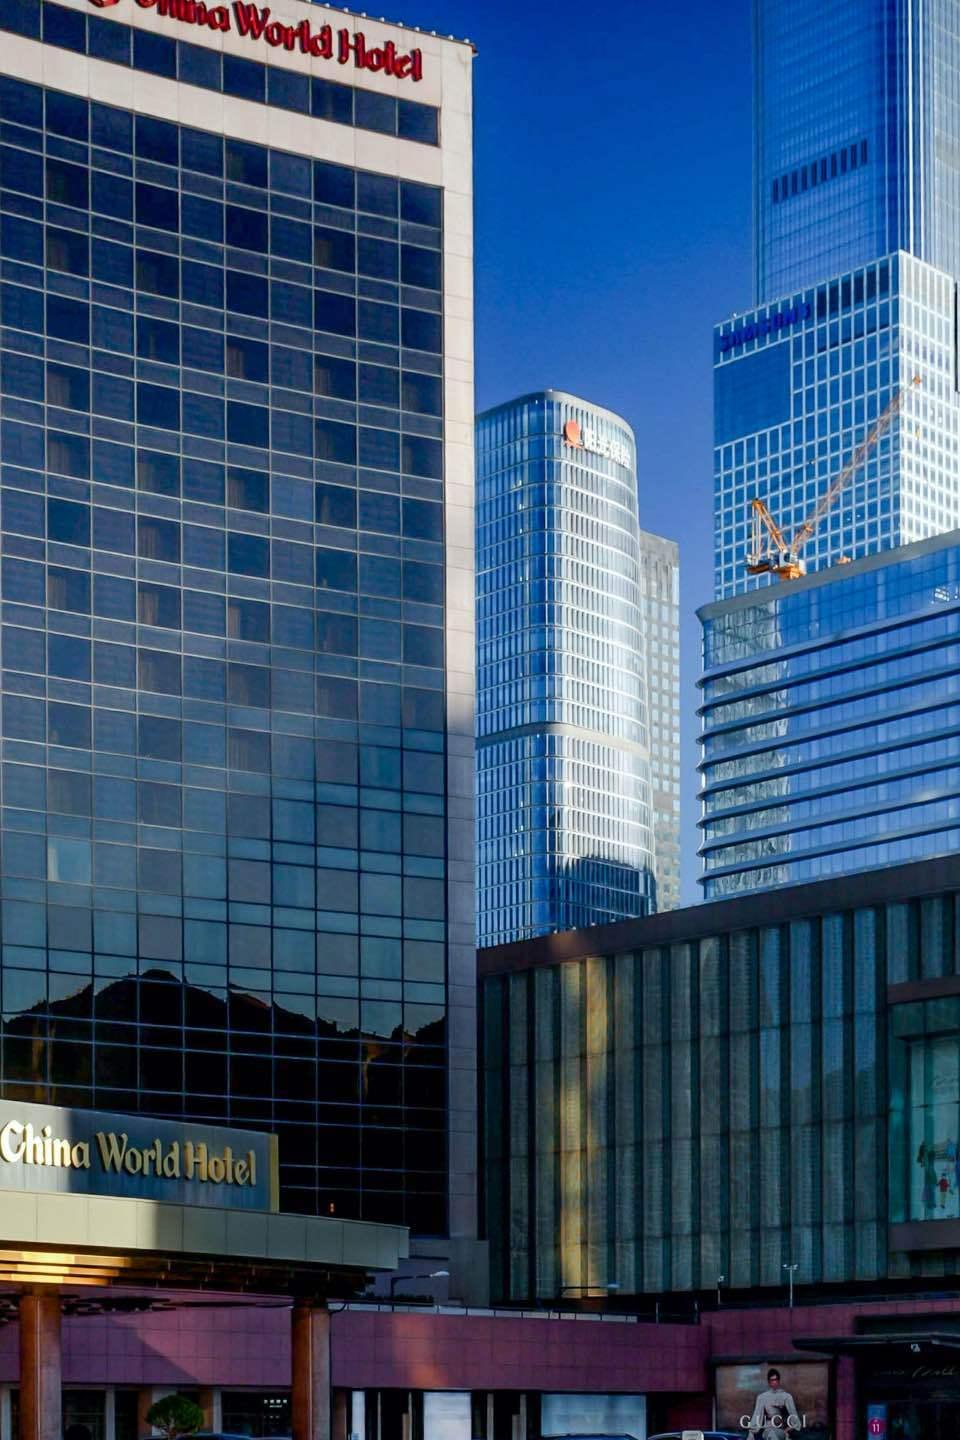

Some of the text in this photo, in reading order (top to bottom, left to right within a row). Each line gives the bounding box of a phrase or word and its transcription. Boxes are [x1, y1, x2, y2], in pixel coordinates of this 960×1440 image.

[233, 1, 334, 59] World
[338, 29, 423, 82] Hotel
[96, 1131, 181, 1178] World
[185, 1140, 257, 1186] Hotel
[740, 1414, 807, 1429] GUCCI
